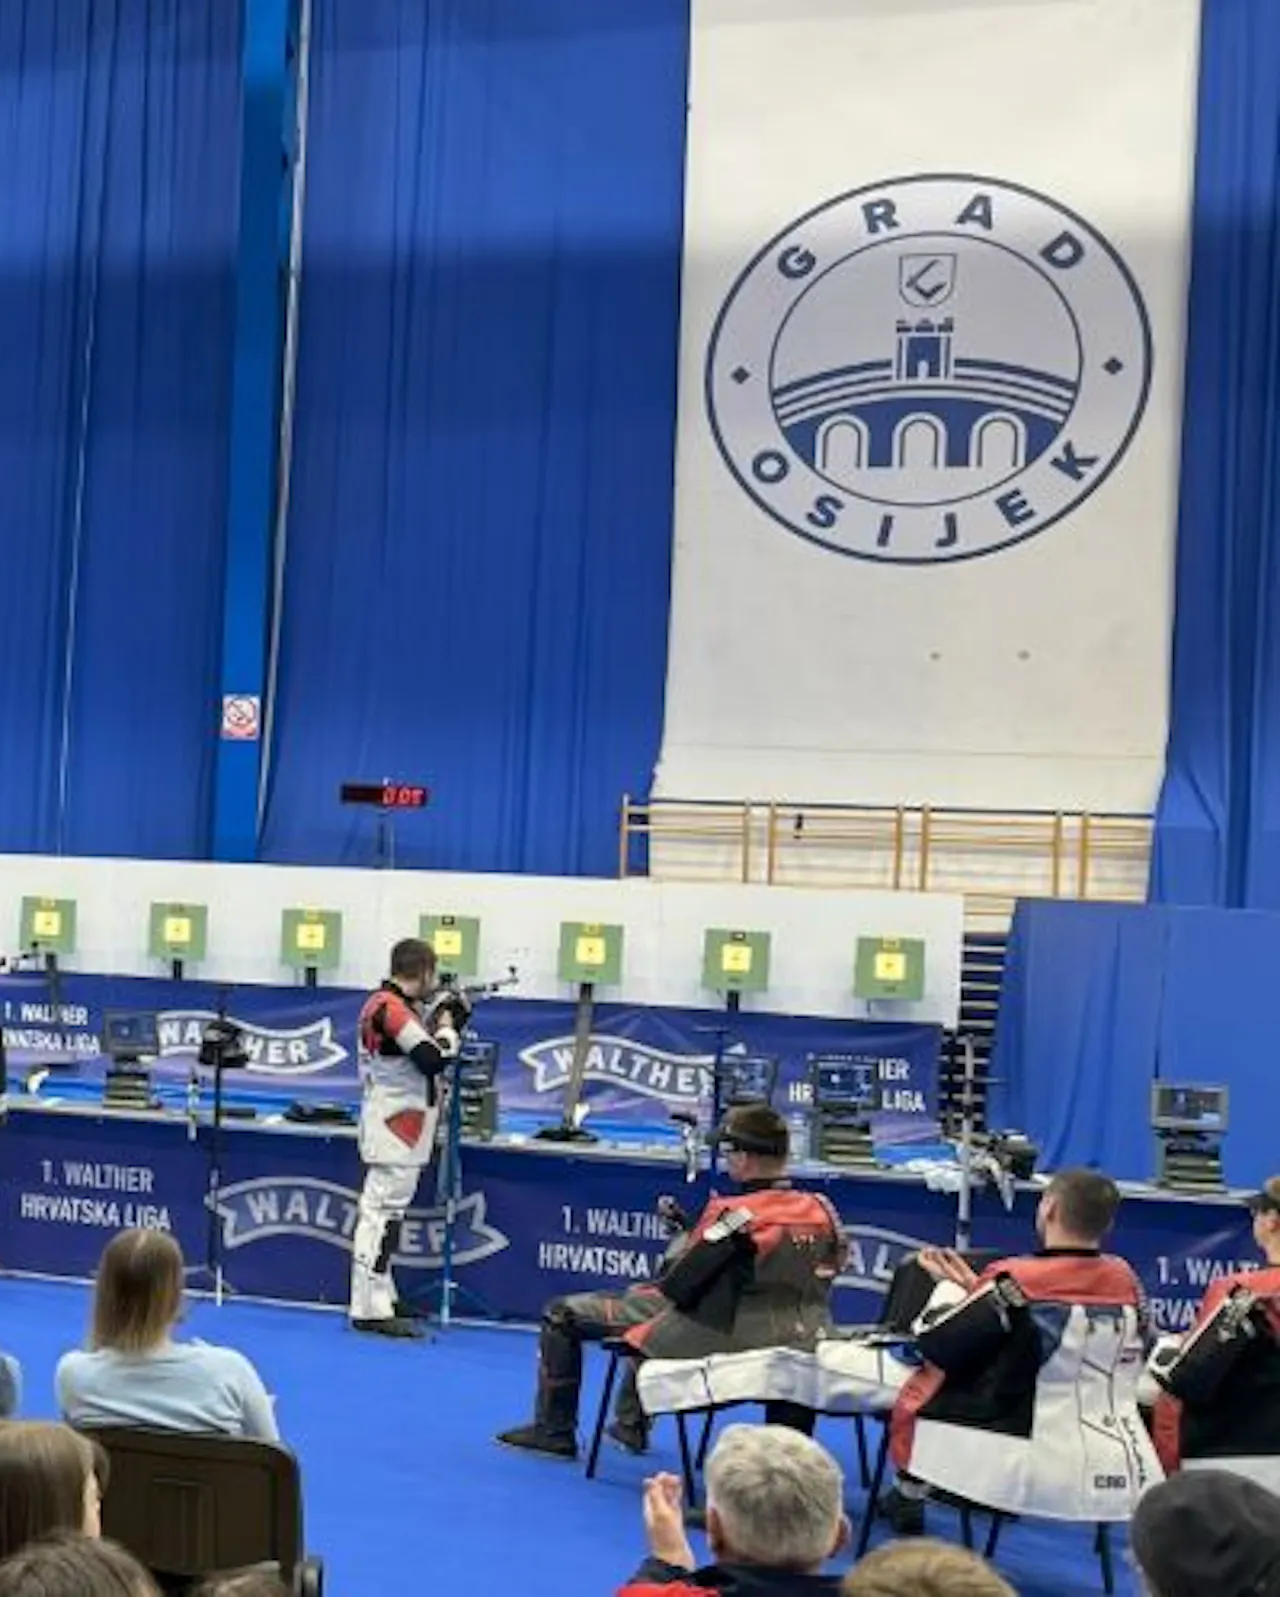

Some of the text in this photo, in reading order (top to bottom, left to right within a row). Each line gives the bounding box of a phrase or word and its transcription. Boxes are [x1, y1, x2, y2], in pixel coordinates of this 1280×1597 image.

[776, 194, 1085, 280] GRAD
[751, 440, 1101, 549] OSIJEK
[41, 1160, 154, 1194] 1. WALTHER
[20, 1192, 172, 1232] HRVATSKA LIGA
[562, 1204, 581, 1235] 1.
[538, 1241, 651, 1280] HRVATSKA
[1156, 1256, 1180, 1287] 1.
